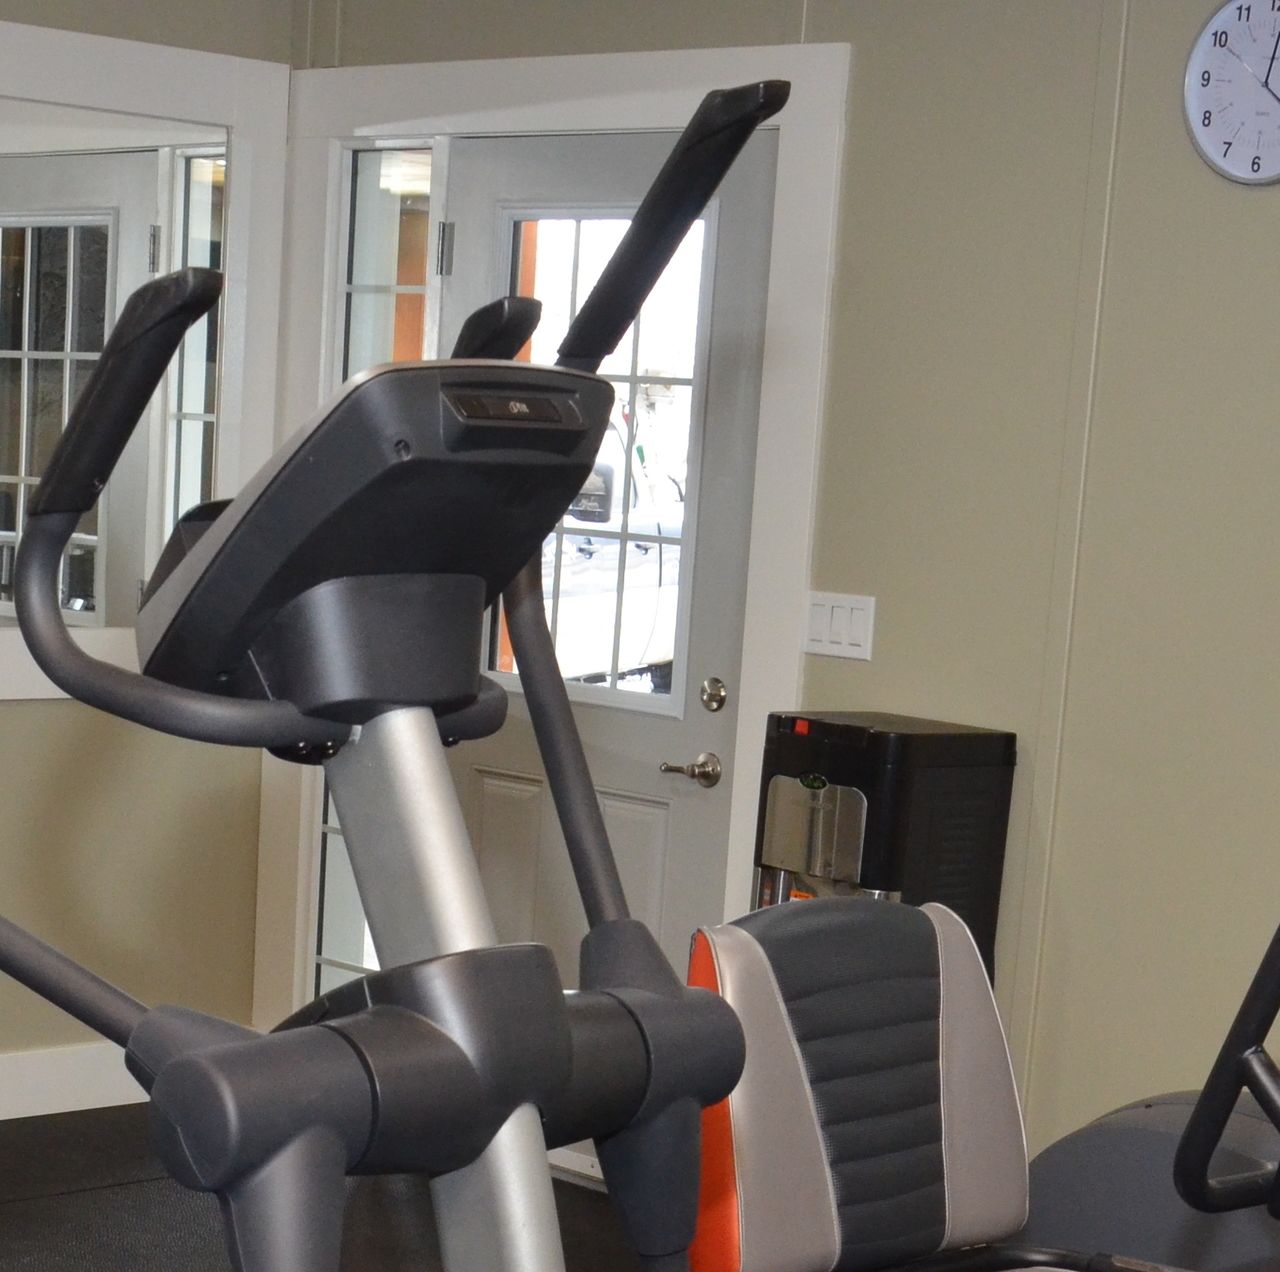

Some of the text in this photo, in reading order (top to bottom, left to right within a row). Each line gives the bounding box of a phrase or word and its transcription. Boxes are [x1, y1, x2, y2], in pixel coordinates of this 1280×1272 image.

[1236, 5, 1252, 22] 11
[1212, 30, 1228, 48] 10
[1201, 70, 1211, 87] 9
[1202, 110, 1212, 127] 8
[1223, 141, 1232, 158] 7
[1251, 156, 1261, 173] 6
